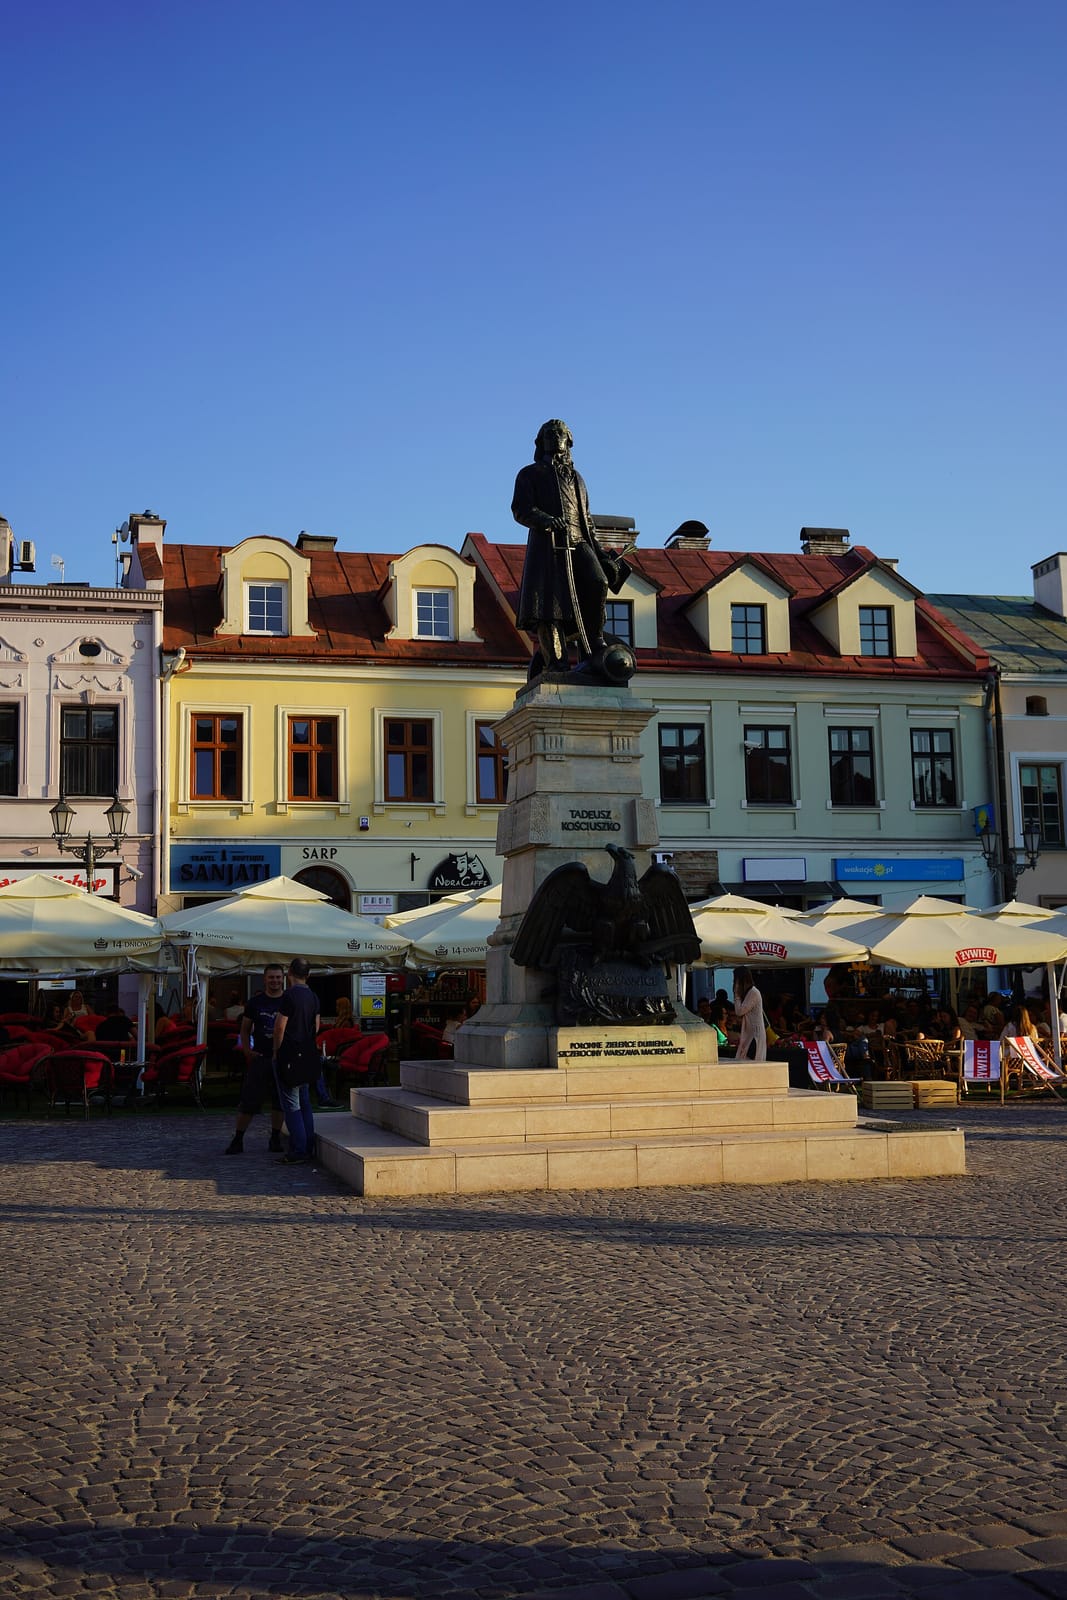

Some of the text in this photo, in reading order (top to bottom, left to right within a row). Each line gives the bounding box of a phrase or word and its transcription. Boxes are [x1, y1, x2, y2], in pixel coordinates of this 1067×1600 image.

[569, 809, 611, 819] TADEUSZ
[561, 820, 621, 831] KOŚCIUSZKO
[302, 847, 338, 860] SARP
[180, 863, 270, 885] SANJATI
[749, 941, 783, 953] ŻYWIEC
[959, 948, 992, 961] ŻYWIEC
